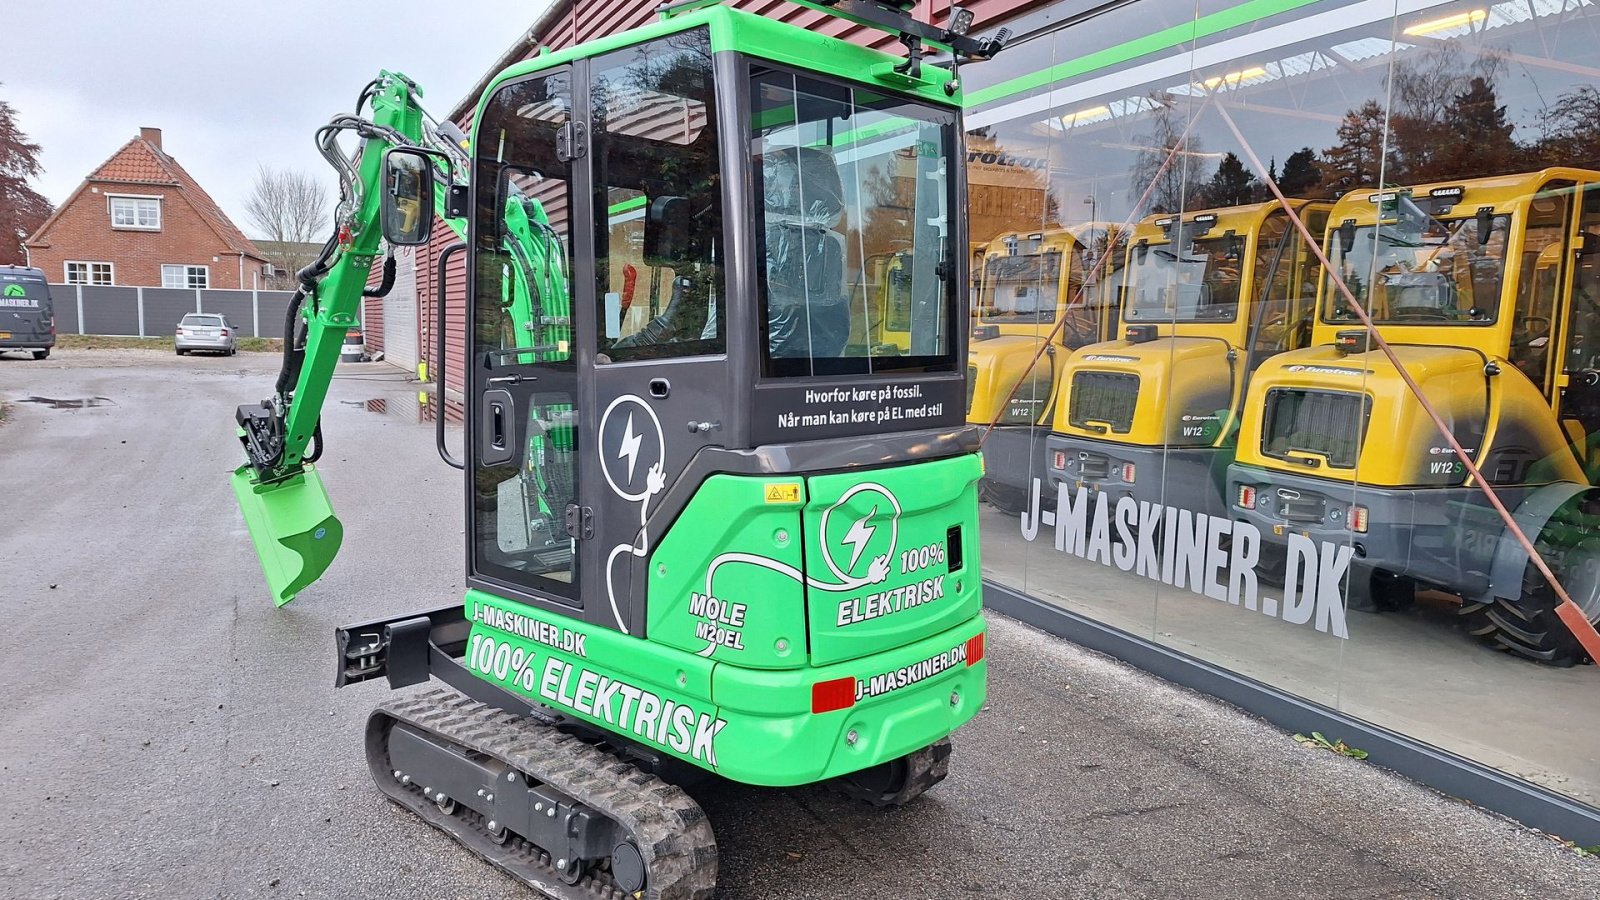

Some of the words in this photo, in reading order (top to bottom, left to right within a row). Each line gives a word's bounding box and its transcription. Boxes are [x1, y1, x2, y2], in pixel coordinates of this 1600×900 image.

[805, 388, 850, 403] Hvorfor
[852, 387, 877, 402] køre
[878, 386, 891, 403] på
[893, 384, 922, 399] fossil.
[778, 412, 800, 428] Når
[802, 414, 827, 426] man
[829, 410, 849, 424] kan
[851, 409, 876, 423] køre
[877, 406, 890, 424] på
[891, 407, 903, 420] EL
[905, 404, 926, 418] med
[927, 402, 943, 417] stil
[1012, 408, 1029, 416] W12
[1183, 426, 1203, 436] W12
[1204, 426, 1211, 436] S
[1430, 462, 1453, 474] W12
[1454, 461, 1463, 473] S
[900, 542, 946, 575] 100%
[1020, 477, 1356, 640] J-MASKINER.DK
[688, 592, 747, 627] MOLE
[836, 575, 946, 627] ELEKTRISK
[473, 601, 587, 657] J-MASKINER.DK
[695, 621, 745, 650] M20EL
[855, 642, 967, 701] J-MASKINER.DK
[469, 633, 536, 692] 100%
[539, 656, 727, 768] ELEKTRISK
